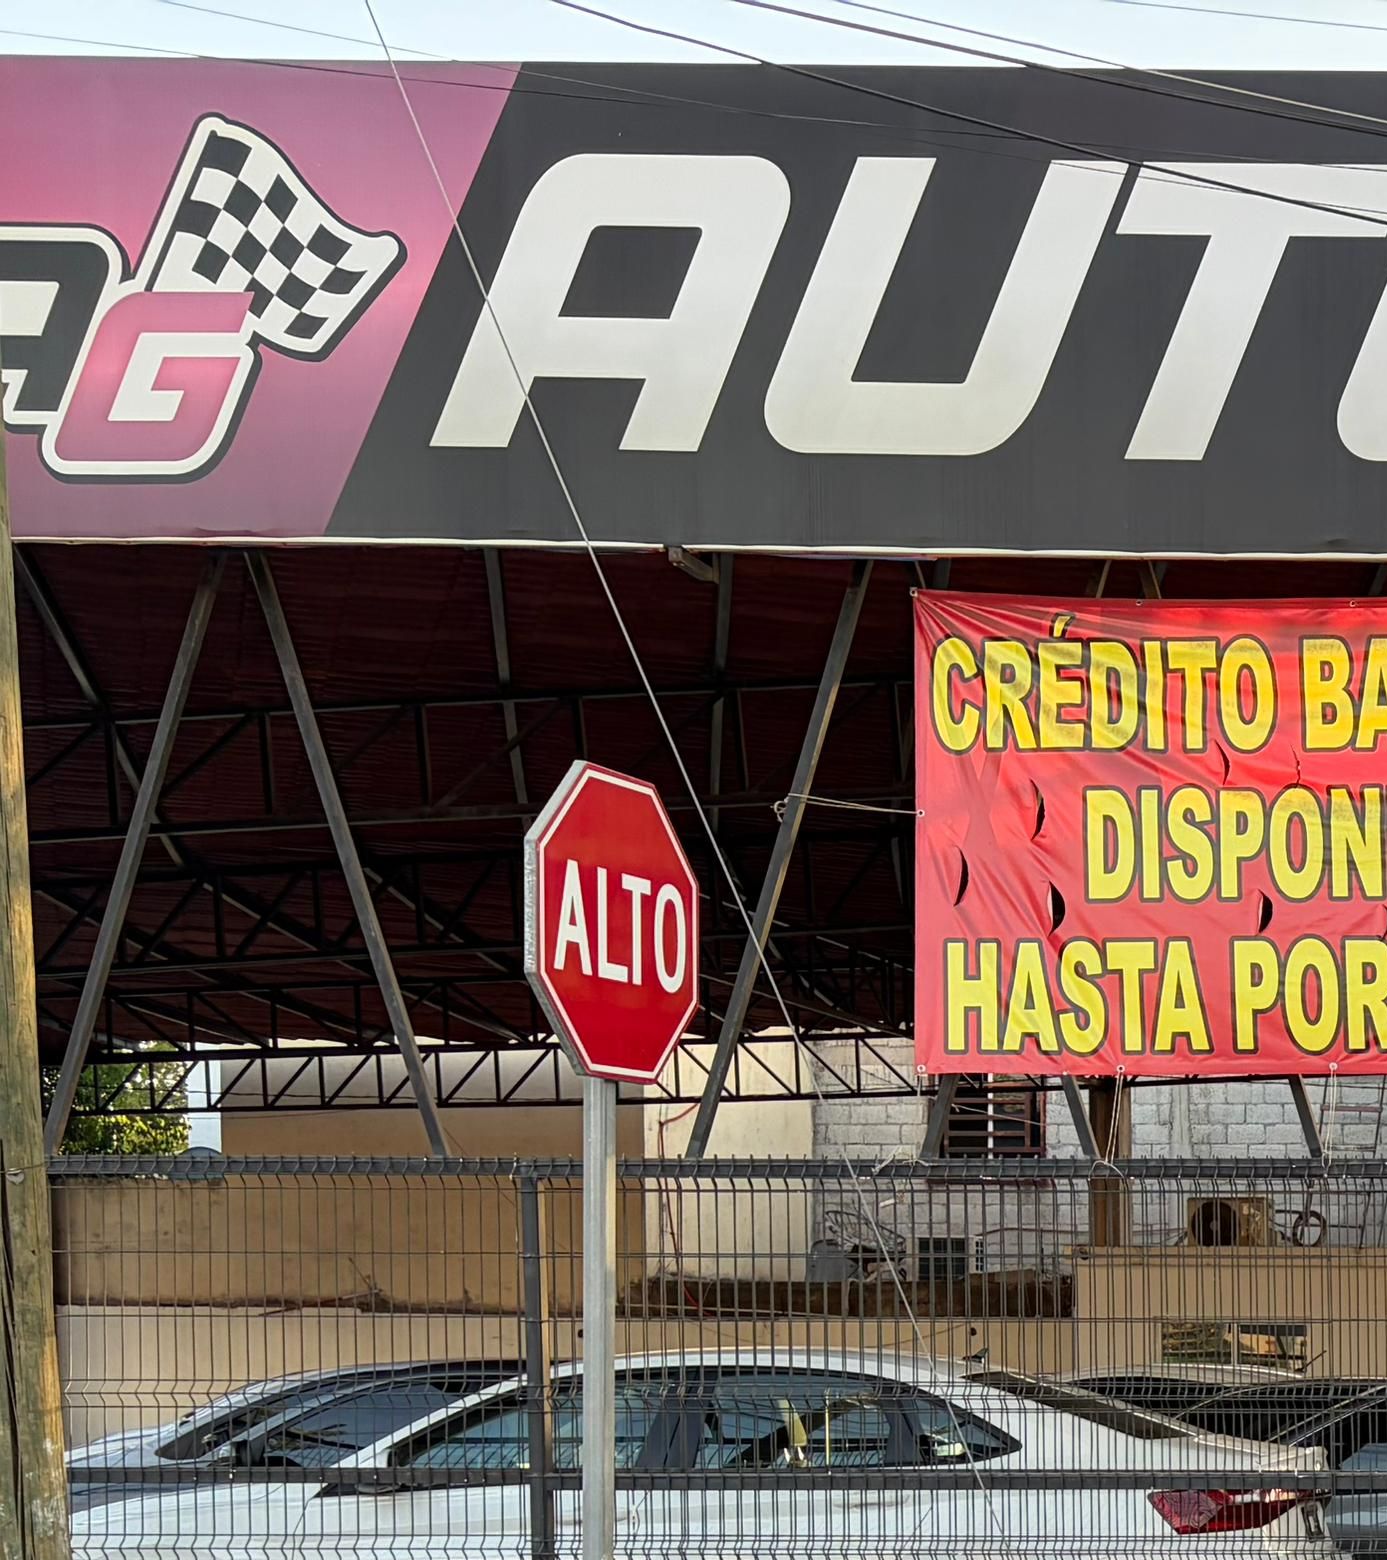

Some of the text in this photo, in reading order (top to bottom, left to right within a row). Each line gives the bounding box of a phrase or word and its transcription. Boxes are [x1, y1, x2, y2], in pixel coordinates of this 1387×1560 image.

[929, 612, 1278, 756] CRÉDITO
[553, 858, 687, 994] ALTO
[942, 934, 1214, 1057] HASTA
